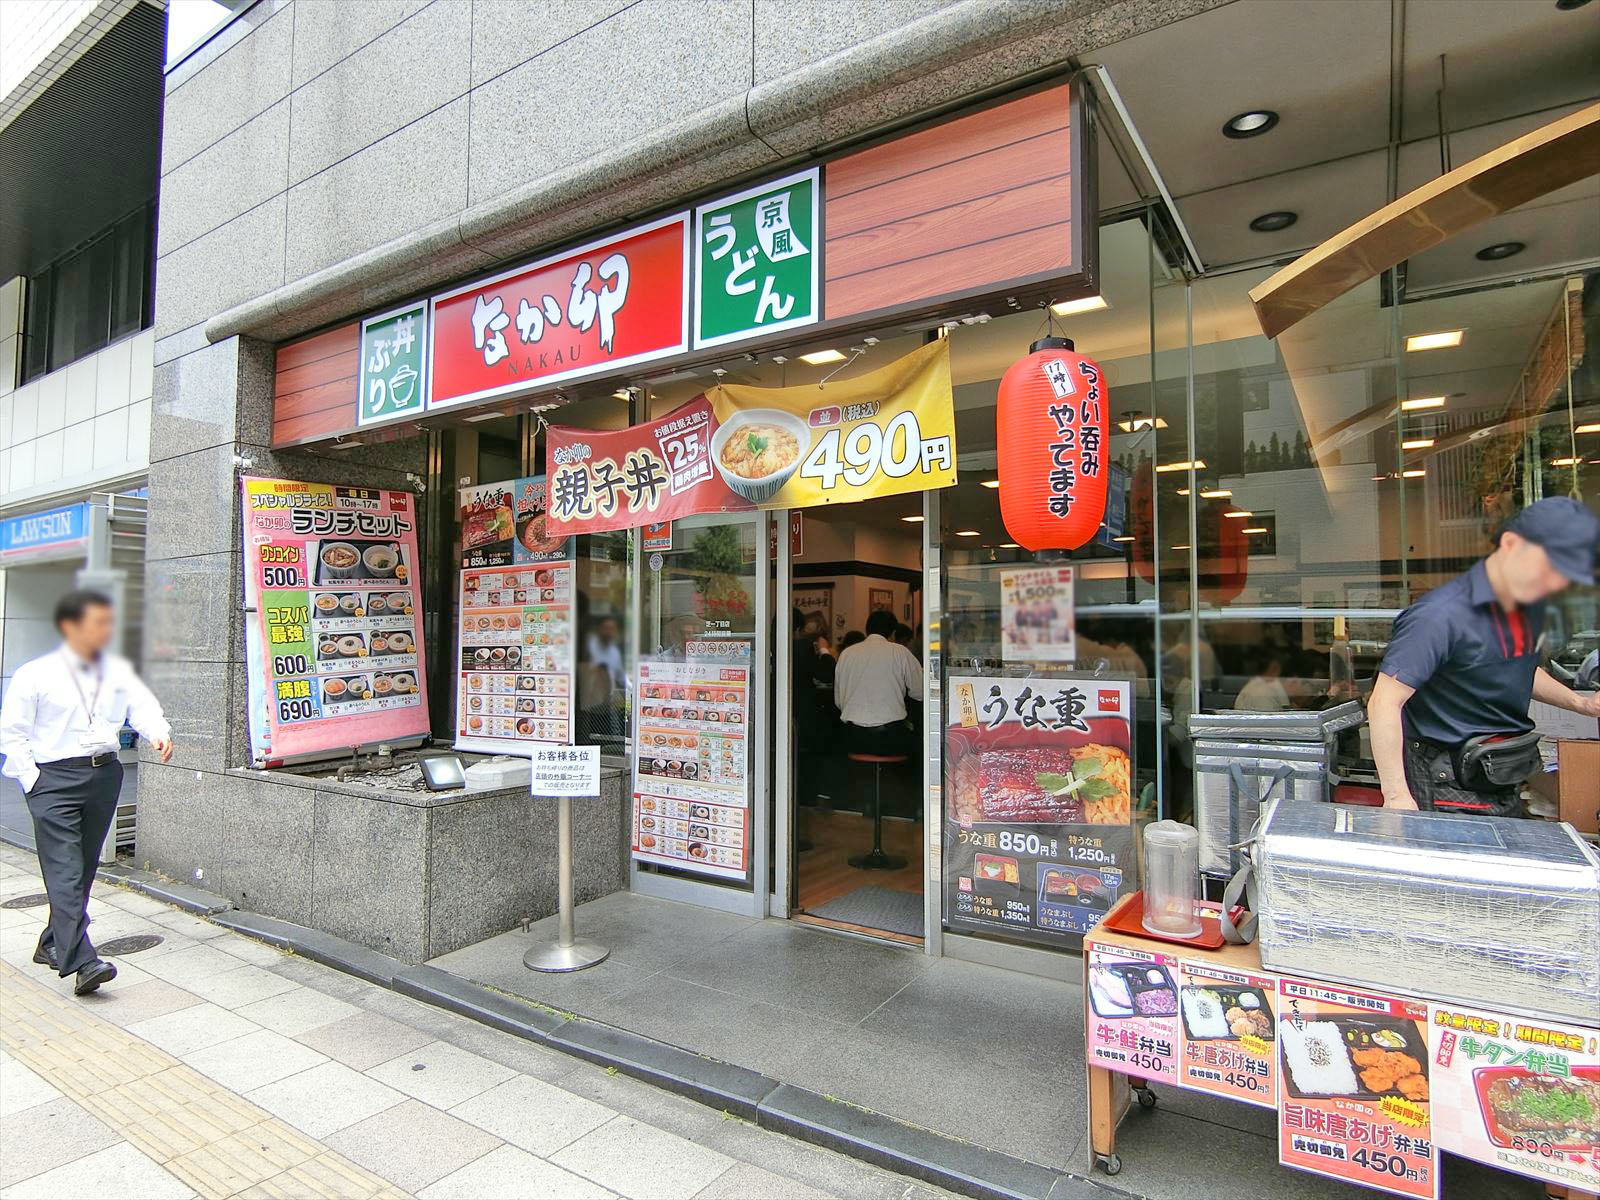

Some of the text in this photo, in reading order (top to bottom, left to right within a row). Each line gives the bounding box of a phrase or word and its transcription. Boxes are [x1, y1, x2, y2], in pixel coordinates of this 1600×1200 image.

[761, 200, 793, 258] 京風
[705, 213, 796, 324] うどん
[470, 252, 631, 367] なか卯
[507, 344, 582, 376] NAKAU
[654, 410, 709, 438] お値段据え置き
[818, 411, 832, 424] 並
[1079, 361, 1100, 477] ちょい呑み
[554, 442, 593, 465] なか卯の
[667, 432, 707, 470] 25%
[800, 410, 952, 490] 490円
[1048, 404, 1075, 518] やってます
[554, 453, 668, 518] 親子丼
[10, 510, 72, 545] LAWSON
[292, 508, 412, 537] ランチセット
[260, 544, 300, 563] ワンコイン
[263, 567, 306, 587] 500円
[267, 606, 309, 624] コスパ
[270, 625, 305, 644] 最強
[274, 654, 315, 676] 600円
[276, 680, 312, 700] 満腹
[1099, 695, 1119, 704] なか卯
[280, 699, 320, 721] 690円
[960, 688, 973, 722] なか卯の
[982, 684, 1089, 732] うな重
[537, 750, 590, 762] お客様各位
[958, 829, 998, 849] うな重
[1000, 831, 1050, 857] 850円
[1068, 834, 1103, 848] 特うな重
[1067, 846, 1110, 864] 1,250円
[1040, 907, 1074, 919] うなまぶし
[1040, 916, 1079, 929] 特うなまぶし
[1288, 999, 1304, 1032] できたて
[1130, 1052, 1170, 1074] 450円
[1459, 1036, 1569, 1078] 牛タン弁当
[1225, 1072, 1265, 1094] 450円
[1382, 1100, 1425, 1124] 当店限定
[1284, 1103, 1431, 1159] 旨味唐あげ弁当
[1293, 1138, 1346, 1160] 売切御免
[1351, 1148, 1418, 1182] 450円
